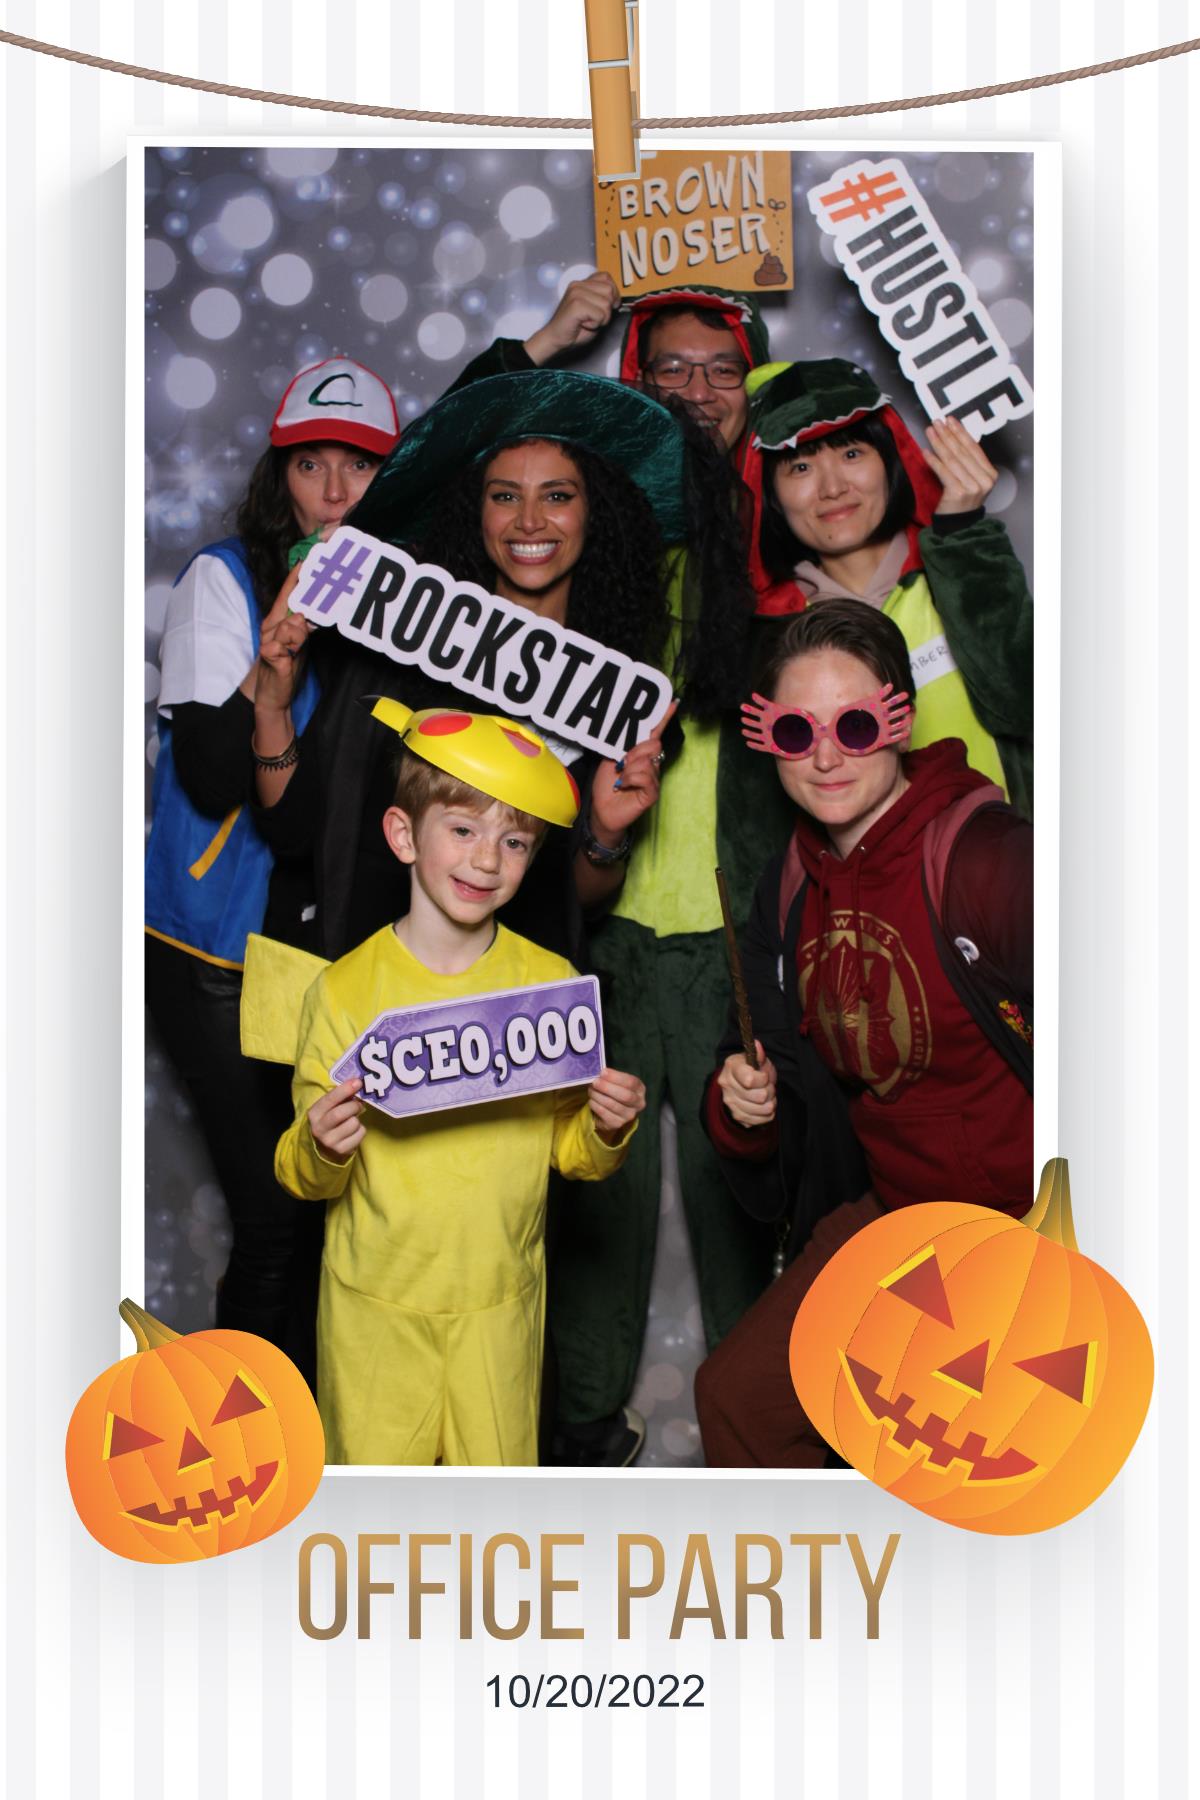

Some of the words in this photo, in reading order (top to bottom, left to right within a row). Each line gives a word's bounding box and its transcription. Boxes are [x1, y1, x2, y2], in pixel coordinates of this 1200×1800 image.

[619, 151, 765, 219] BROWN
[619, 213, 771, 287] NOSER
[818, 170, 1024, 423] #HUSTLE
[300, 538, 660, 752] #ROCKSTAR
